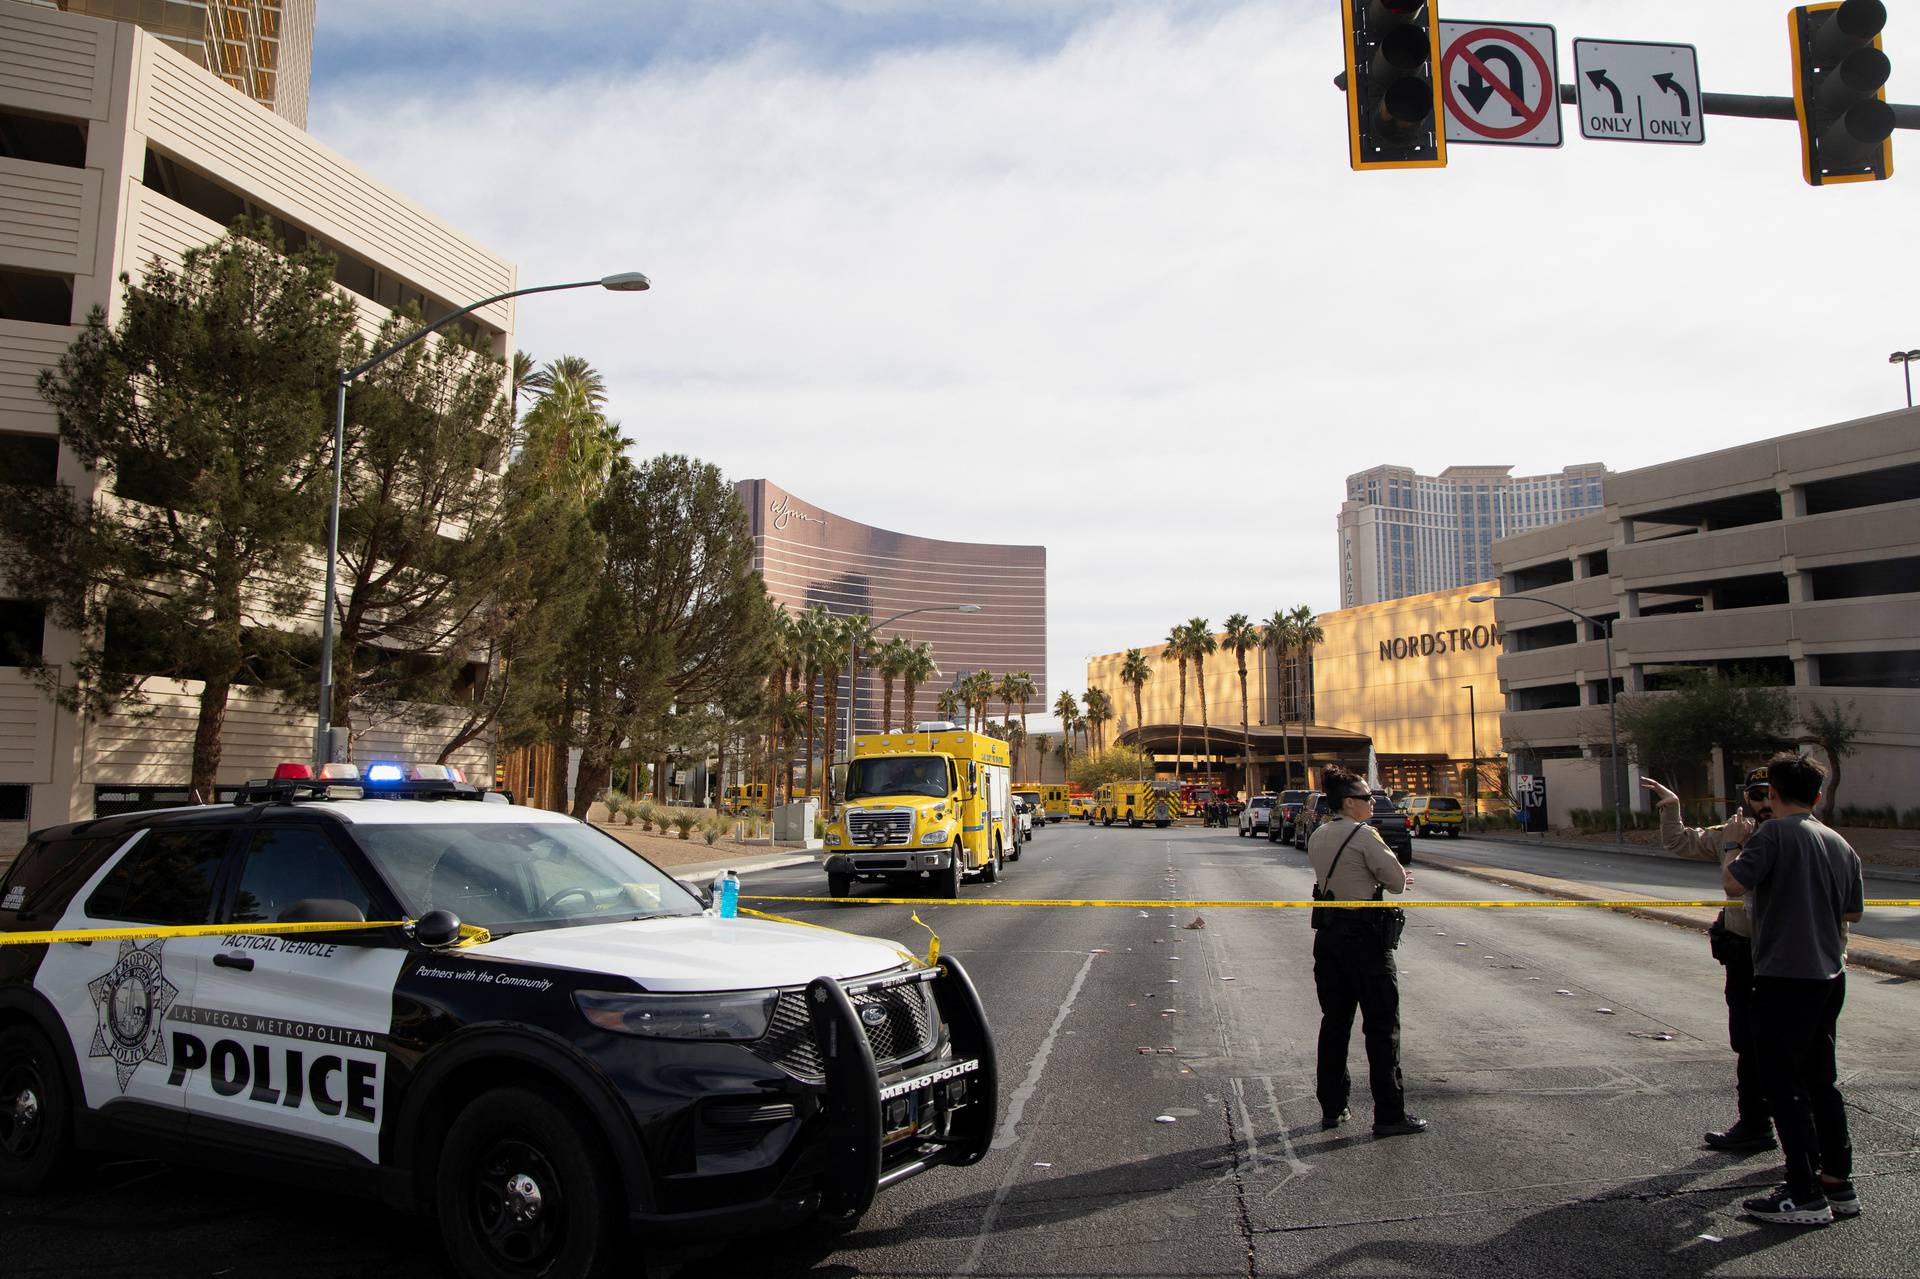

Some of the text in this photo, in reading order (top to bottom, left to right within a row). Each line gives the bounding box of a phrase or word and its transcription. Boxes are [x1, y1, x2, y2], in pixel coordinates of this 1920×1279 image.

[1591, 116, 1691, 136] ONLY ONLY
[1345, 539, 1354, 607] PALAZZ
[1751, 770, 1768, 781] POLI
[220, 934, 337, 958] TACTICAL VEHICLE
[100, 952, 161, 1010] METROPOLITAN
[416, 965, 553, 992] Partners with the Community
[175, 1007, 374, 1048] LAS VEGAS METROPOLITAN
[110, 1040, 150, 1063] POLICE
[168, 1032, 377, 1124] POLICE
[880, 1059, 979, 1100] METRO POLICE
